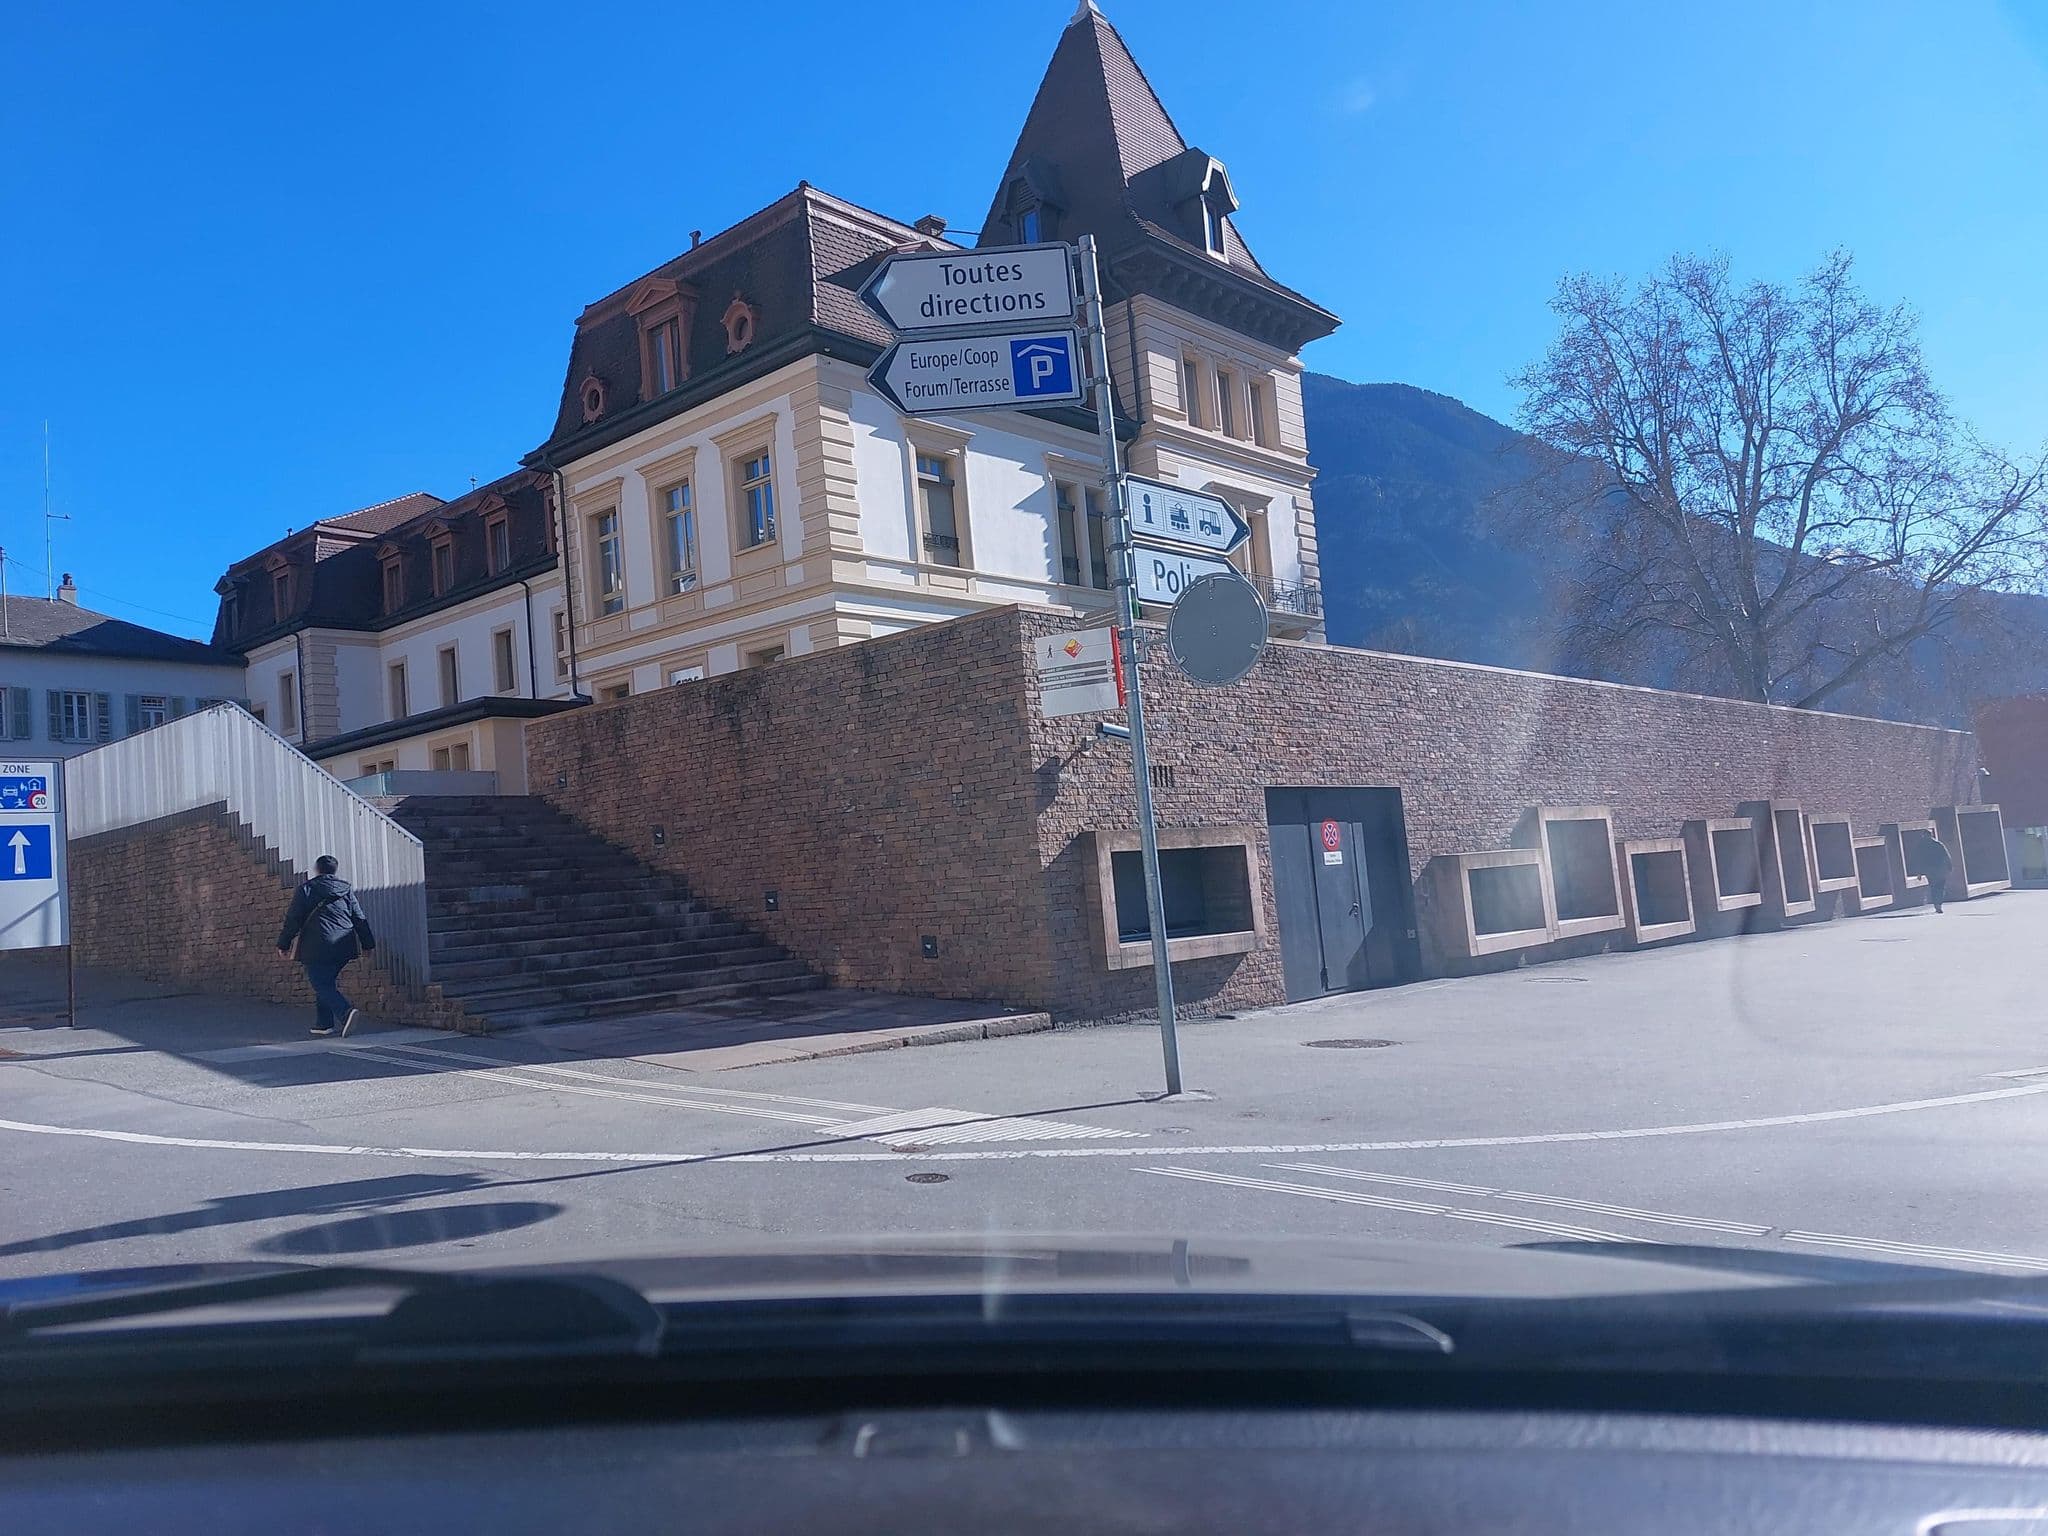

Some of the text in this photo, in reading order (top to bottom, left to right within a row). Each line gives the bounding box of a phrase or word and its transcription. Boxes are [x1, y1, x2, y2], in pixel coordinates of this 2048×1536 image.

[940, 263, 1023, 286] Toutes
[920, 292, 1046, 318] directions
[910, 348, 999, 372] Europe/Coop
[1030, 355, 1054, 389] P
[904, 377, 1010, 399] Forum/Terrasse
[1153, 559, 1203, 594] Poli
[2, 764, 31, 774] ZONE
[35, 796, 46, 806] 20
